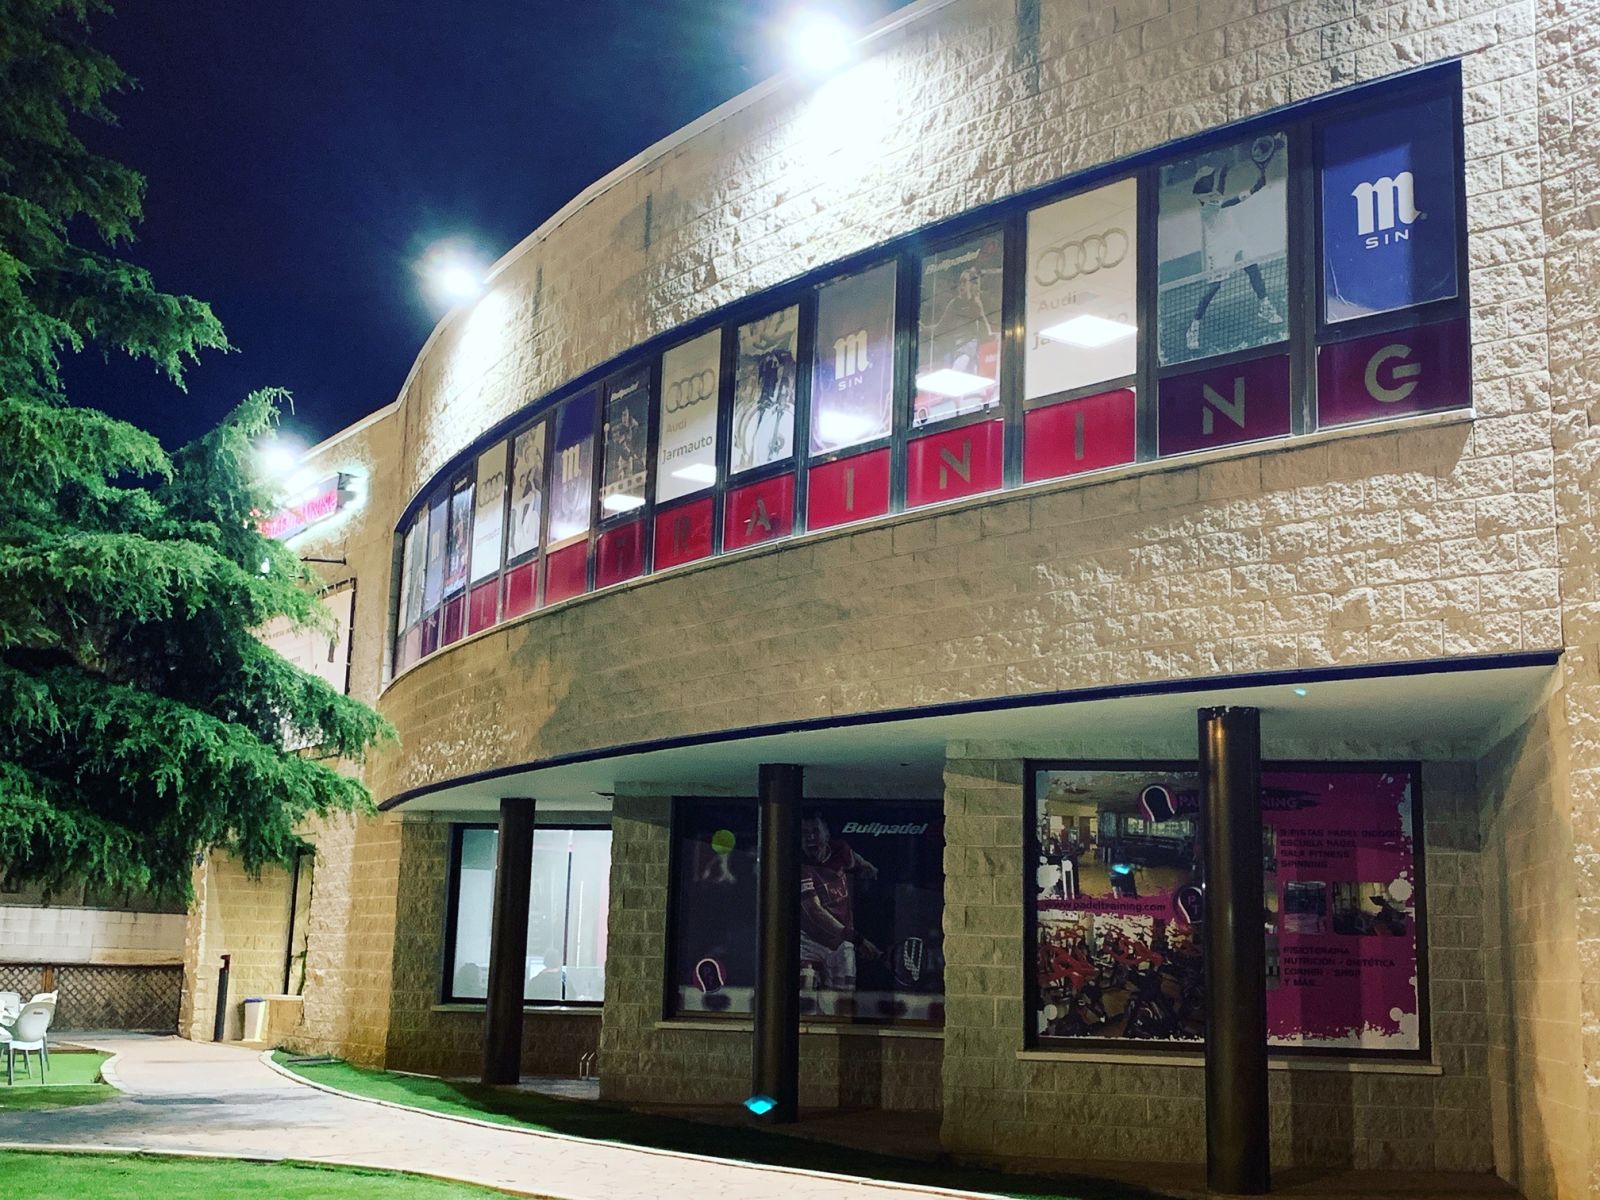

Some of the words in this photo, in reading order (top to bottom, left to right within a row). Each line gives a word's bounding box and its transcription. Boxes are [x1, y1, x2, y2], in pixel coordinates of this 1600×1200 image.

[1364, 228, 1410, 250] SIN
[1037, 291, 1078, 312] Audi
[838, 375, 863, 392] SIN
[665, 418, 688, 435] Audi
[662, 433, 713, 465] Jarmauto
[841, 821, 929, 838] Bullpadel
[1280, 839, 1323, 848] ESCUELA
[1309, 850, 1350, 858] FITNESS
[1281, 860, 1329, 868] SPINNING
[1045, 900, 1166, 913] www.padeltraining.com
